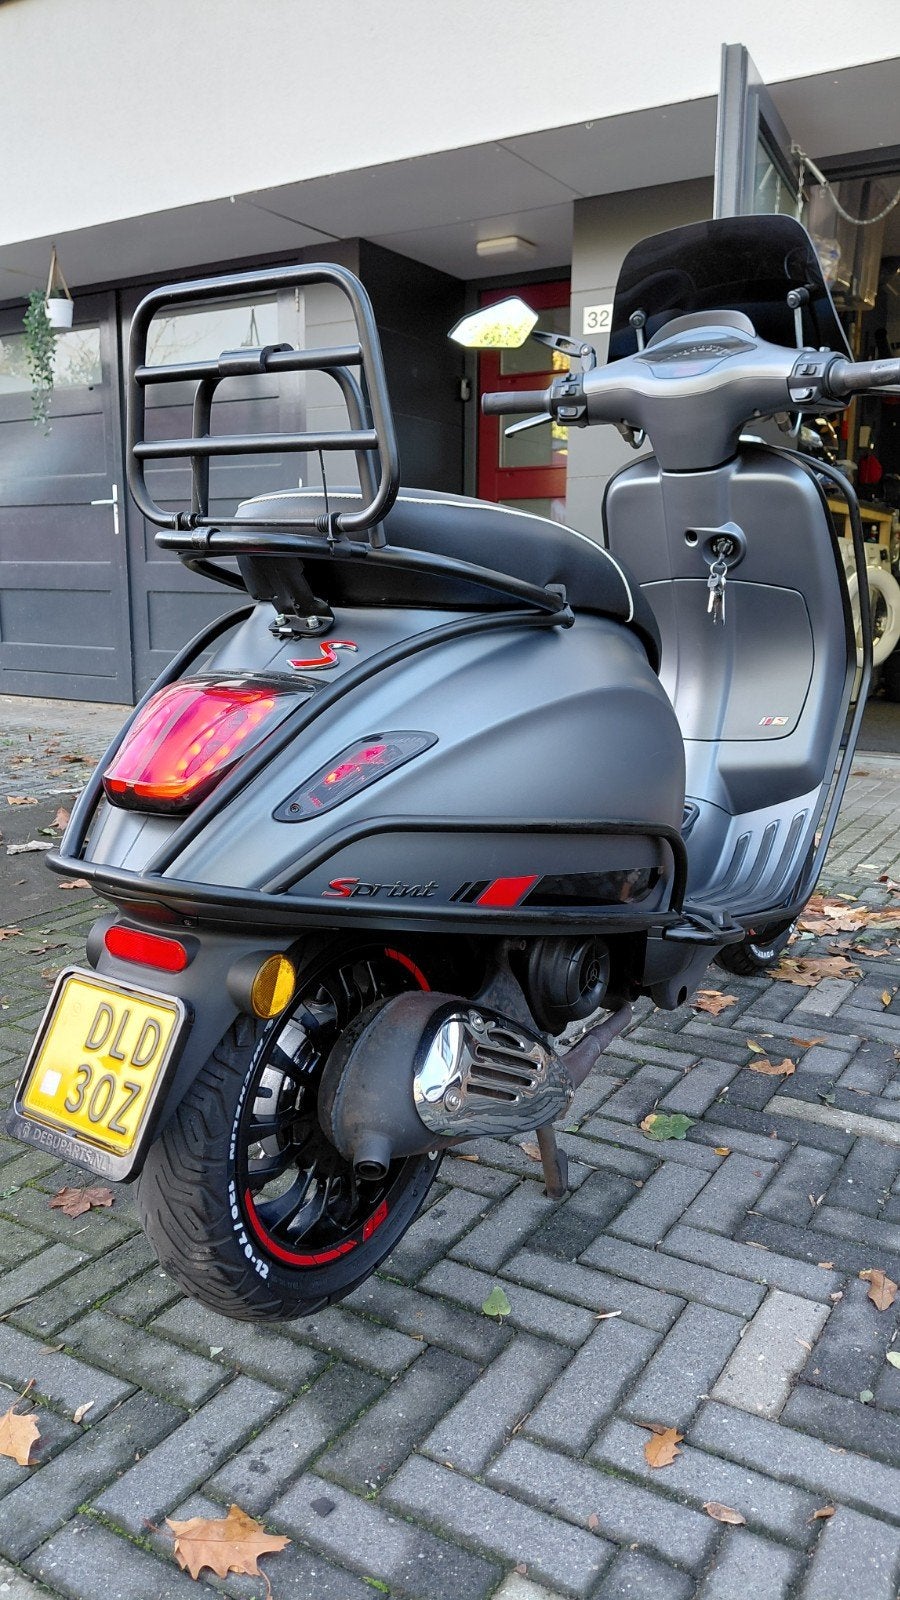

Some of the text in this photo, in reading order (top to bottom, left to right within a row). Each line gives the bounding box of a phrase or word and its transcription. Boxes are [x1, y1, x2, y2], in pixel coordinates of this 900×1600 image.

[587, 310, 610, 328] 32
[321, 877, 439, 898] Sprint
[84, 1002, 162, 1067] DLD
[63, 1063, 142, 1135] 30Z
[229, 1037, 265, 1160] MICHELIN
